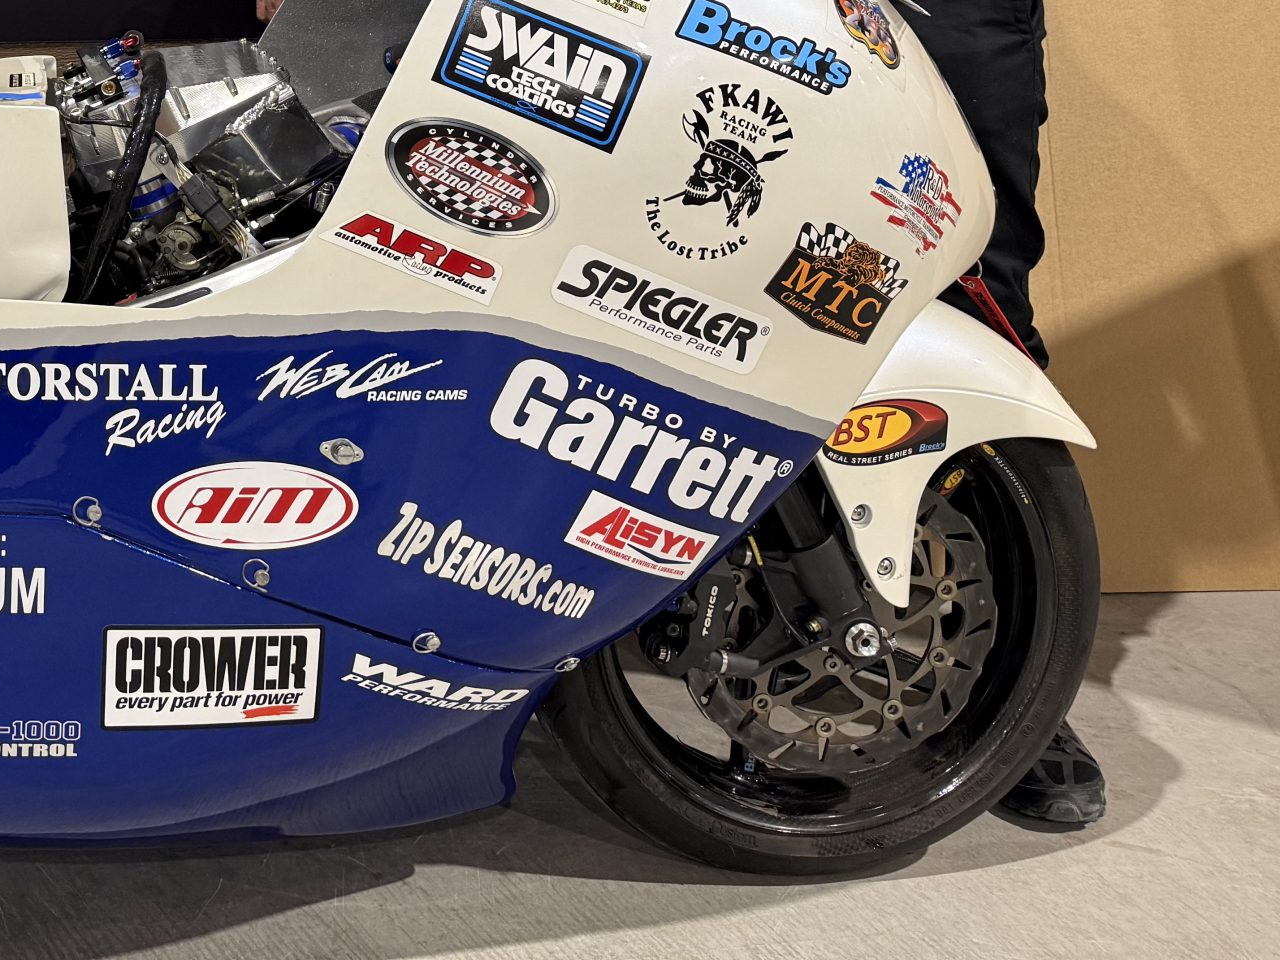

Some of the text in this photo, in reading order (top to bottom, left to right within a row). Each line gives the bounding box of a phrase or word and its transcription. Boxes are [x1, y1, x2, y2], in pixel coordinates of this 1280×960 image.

[719, 40, 830, 92] PERFORMANCE
[696, 83, 794, 144] FKAWI
[720, 110, 767, 138] RACING
[722, 121, 758, 144] TEAM
[419, 140, 526, 200] Millennium
[429, 128, 538, 184] CYLINDER
[405, 152, 522, 217] Technologies
[406, 173, 513, 229] SERVICES
[340, 213, 496, 279] ARP
[645, 196, 749, 261] The Lost Tribe
[334, 230, 402, 263] automotive
[433, 269, 487, 296] products
[556, 258, 758, 363] SPIEGLER
[780, 258, 882, 328] MTC
[780, 291, 861, 340] Clutch Components
[588, 297, 723, 359] Performance Parts
[367, 388, 468, 402] RACING CAMS
[577, 374, 737, 448] TURBO BY
[105, 400, 227, 456] Racing
[489, 358, 780, 523] Garrett
[827, 448, 913, 464] REAL STREET SERIES
[832, 411, 897, 446] BST
[377, 502, 435, 566] ZIP
[575, 535, 590, 546] HIGH
[702, 585, 719, 637] TOKICO
[115, 635, 308, 694] CROWER
[341, 674, 510, 711] PERFORMANCE
[353, 653, 530, 705] WARD
[115, 690, 303, 712] every part for power
